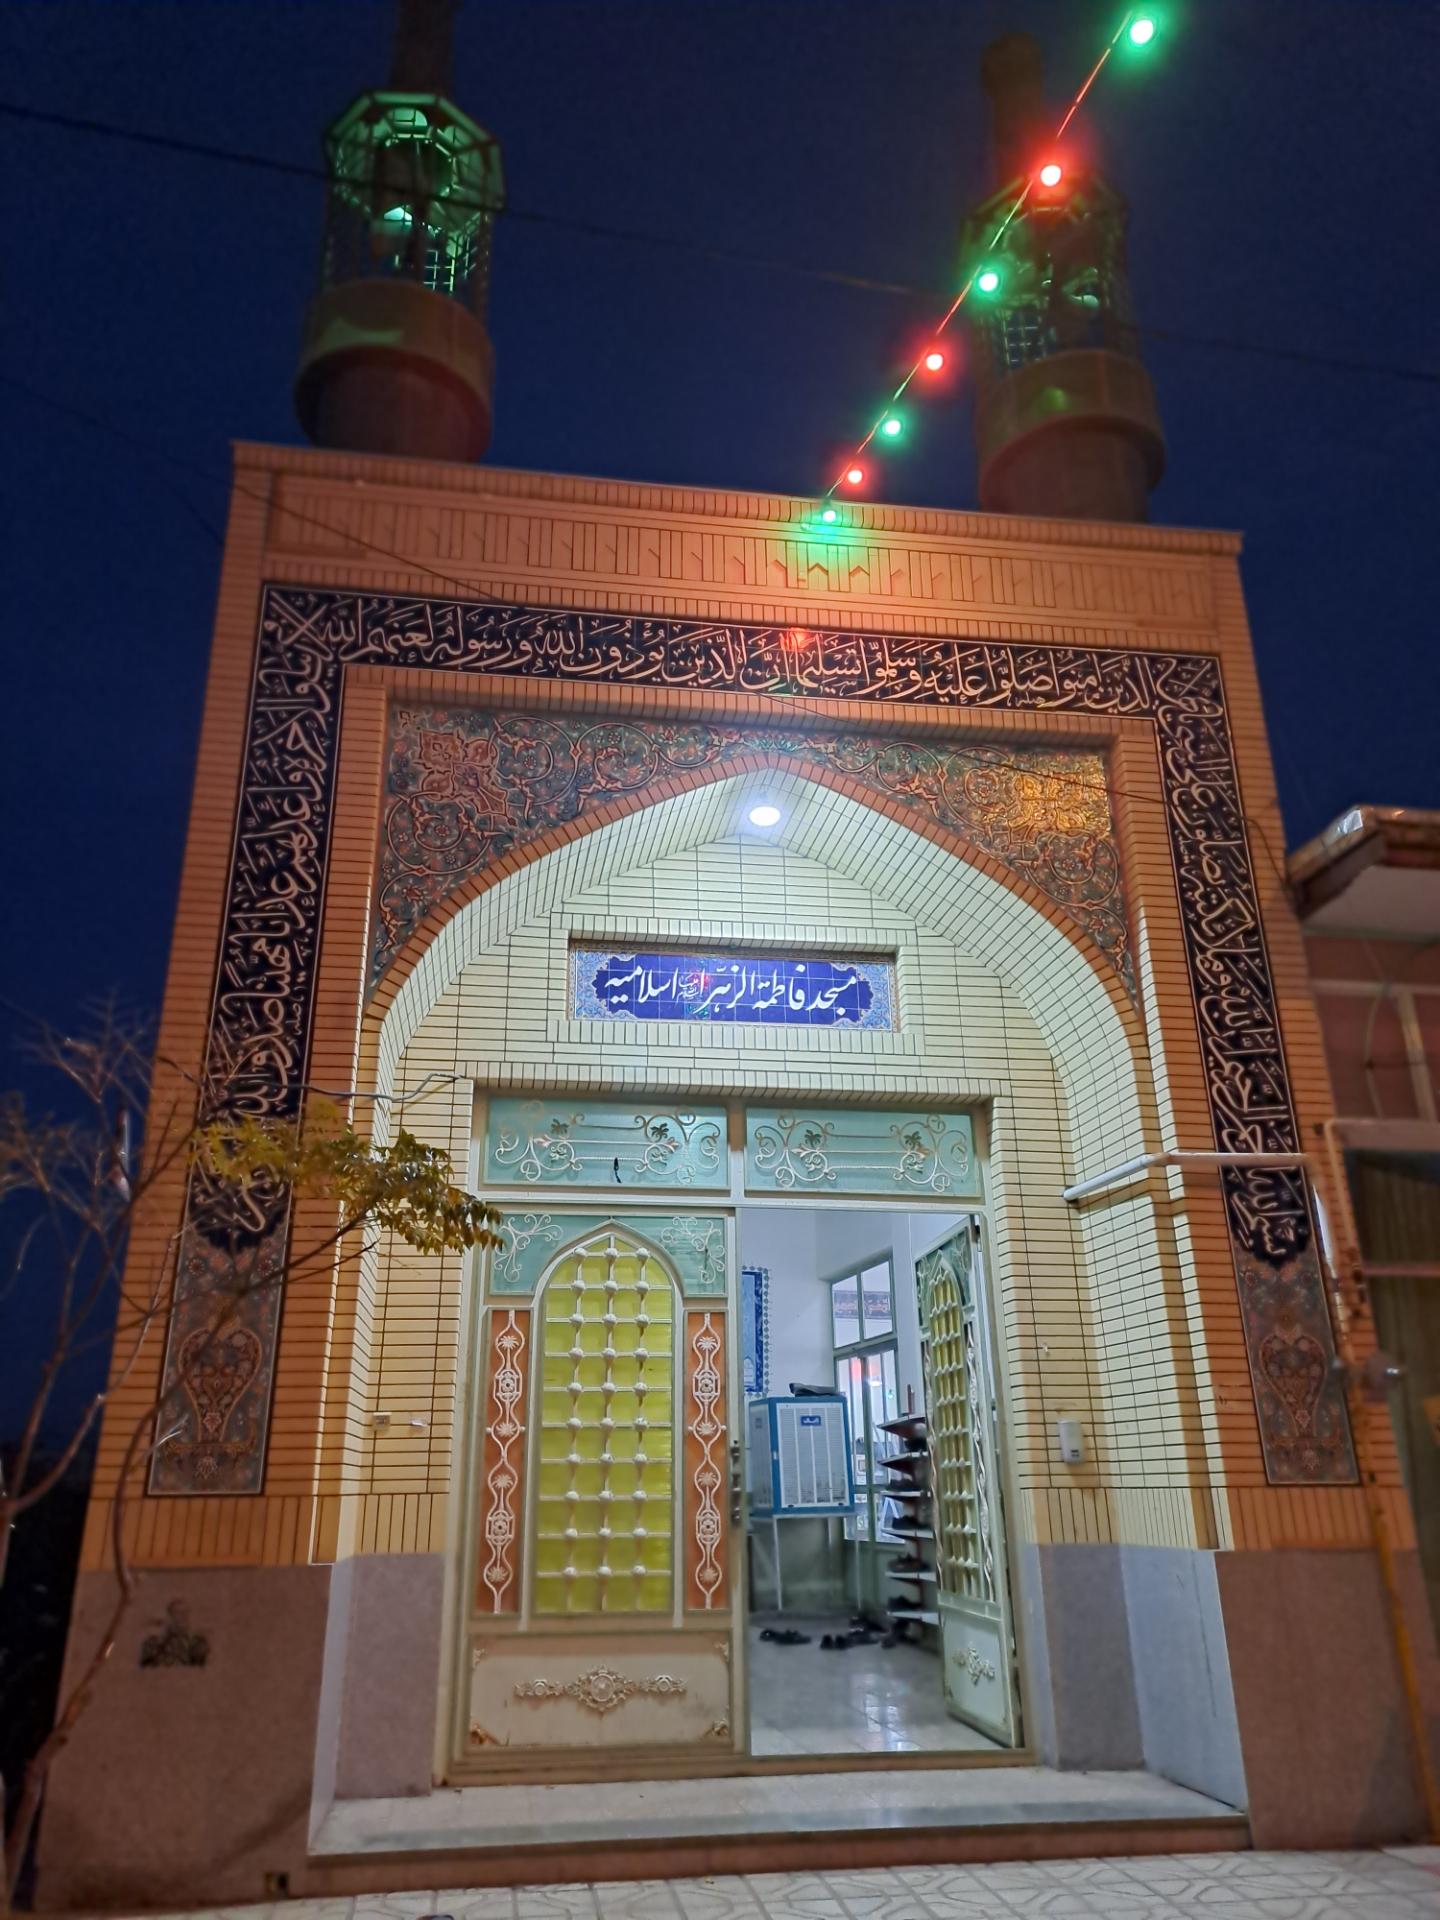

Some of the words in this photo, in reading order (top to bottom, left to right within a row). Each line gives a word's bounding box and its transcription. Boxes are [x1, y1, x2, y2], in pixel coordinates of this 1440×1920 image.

[320, 596, 361, 645] الله
[534, 614, 583, 657] الله
[806, 975, 857, 1015] مسجد
[1222, 986, 1274, 1033] الله
